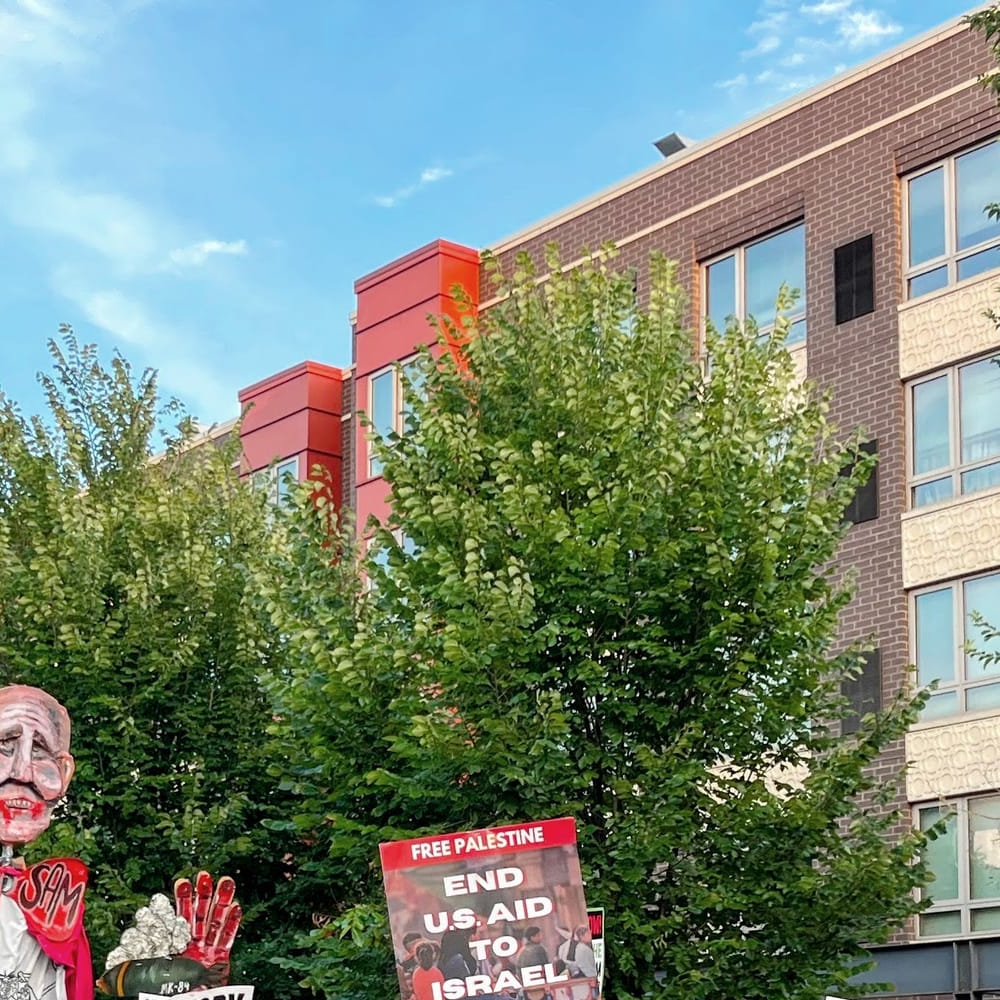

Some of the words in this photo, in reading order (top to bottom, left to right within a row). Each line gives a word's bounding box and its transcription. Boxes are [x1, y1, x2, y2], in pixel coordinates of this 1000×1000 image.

[411, 840, 451, 861] FREE
[454, 827, 545, 854] PALESTINE
[18, 862, 85, 928] SAM
[442, 867, 524, 897] END
[423, 907, 482, 934] U.S.
[487, 896, 553, 926] AID
[468, 935, 518, 961] TO
[160, 981, 190, 994] MK-84
